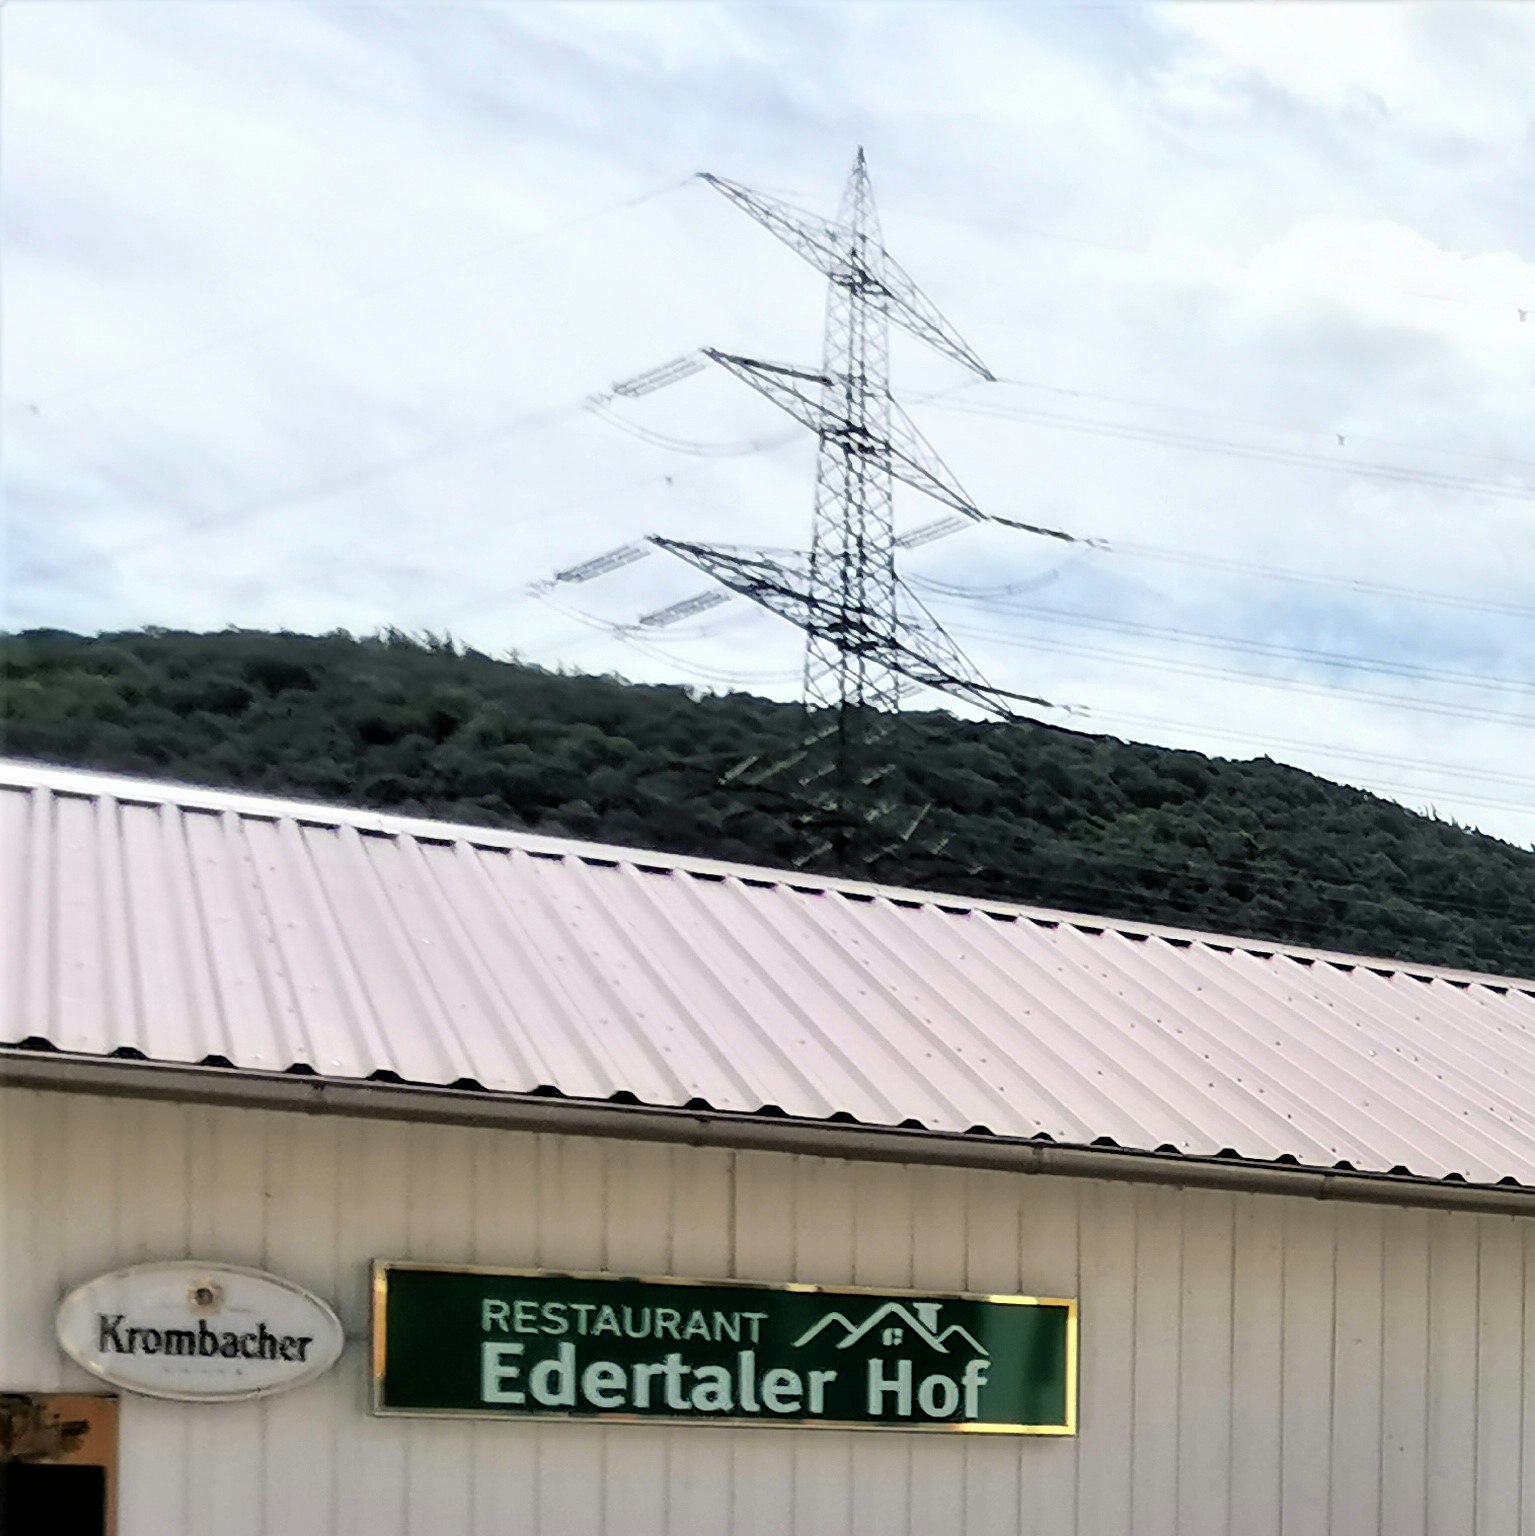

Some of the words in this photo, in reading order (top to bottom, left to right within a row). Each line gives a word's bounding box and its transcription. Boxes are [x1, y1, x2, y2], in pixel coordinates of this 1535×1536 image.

[97, 1311, 313, 1363] Krombacher
[480, 1298, 769, 1344] RESTAURANT
[479, 1340, 838, 1414] Edertaler
[866, 1357, 992, 1419] Hof
